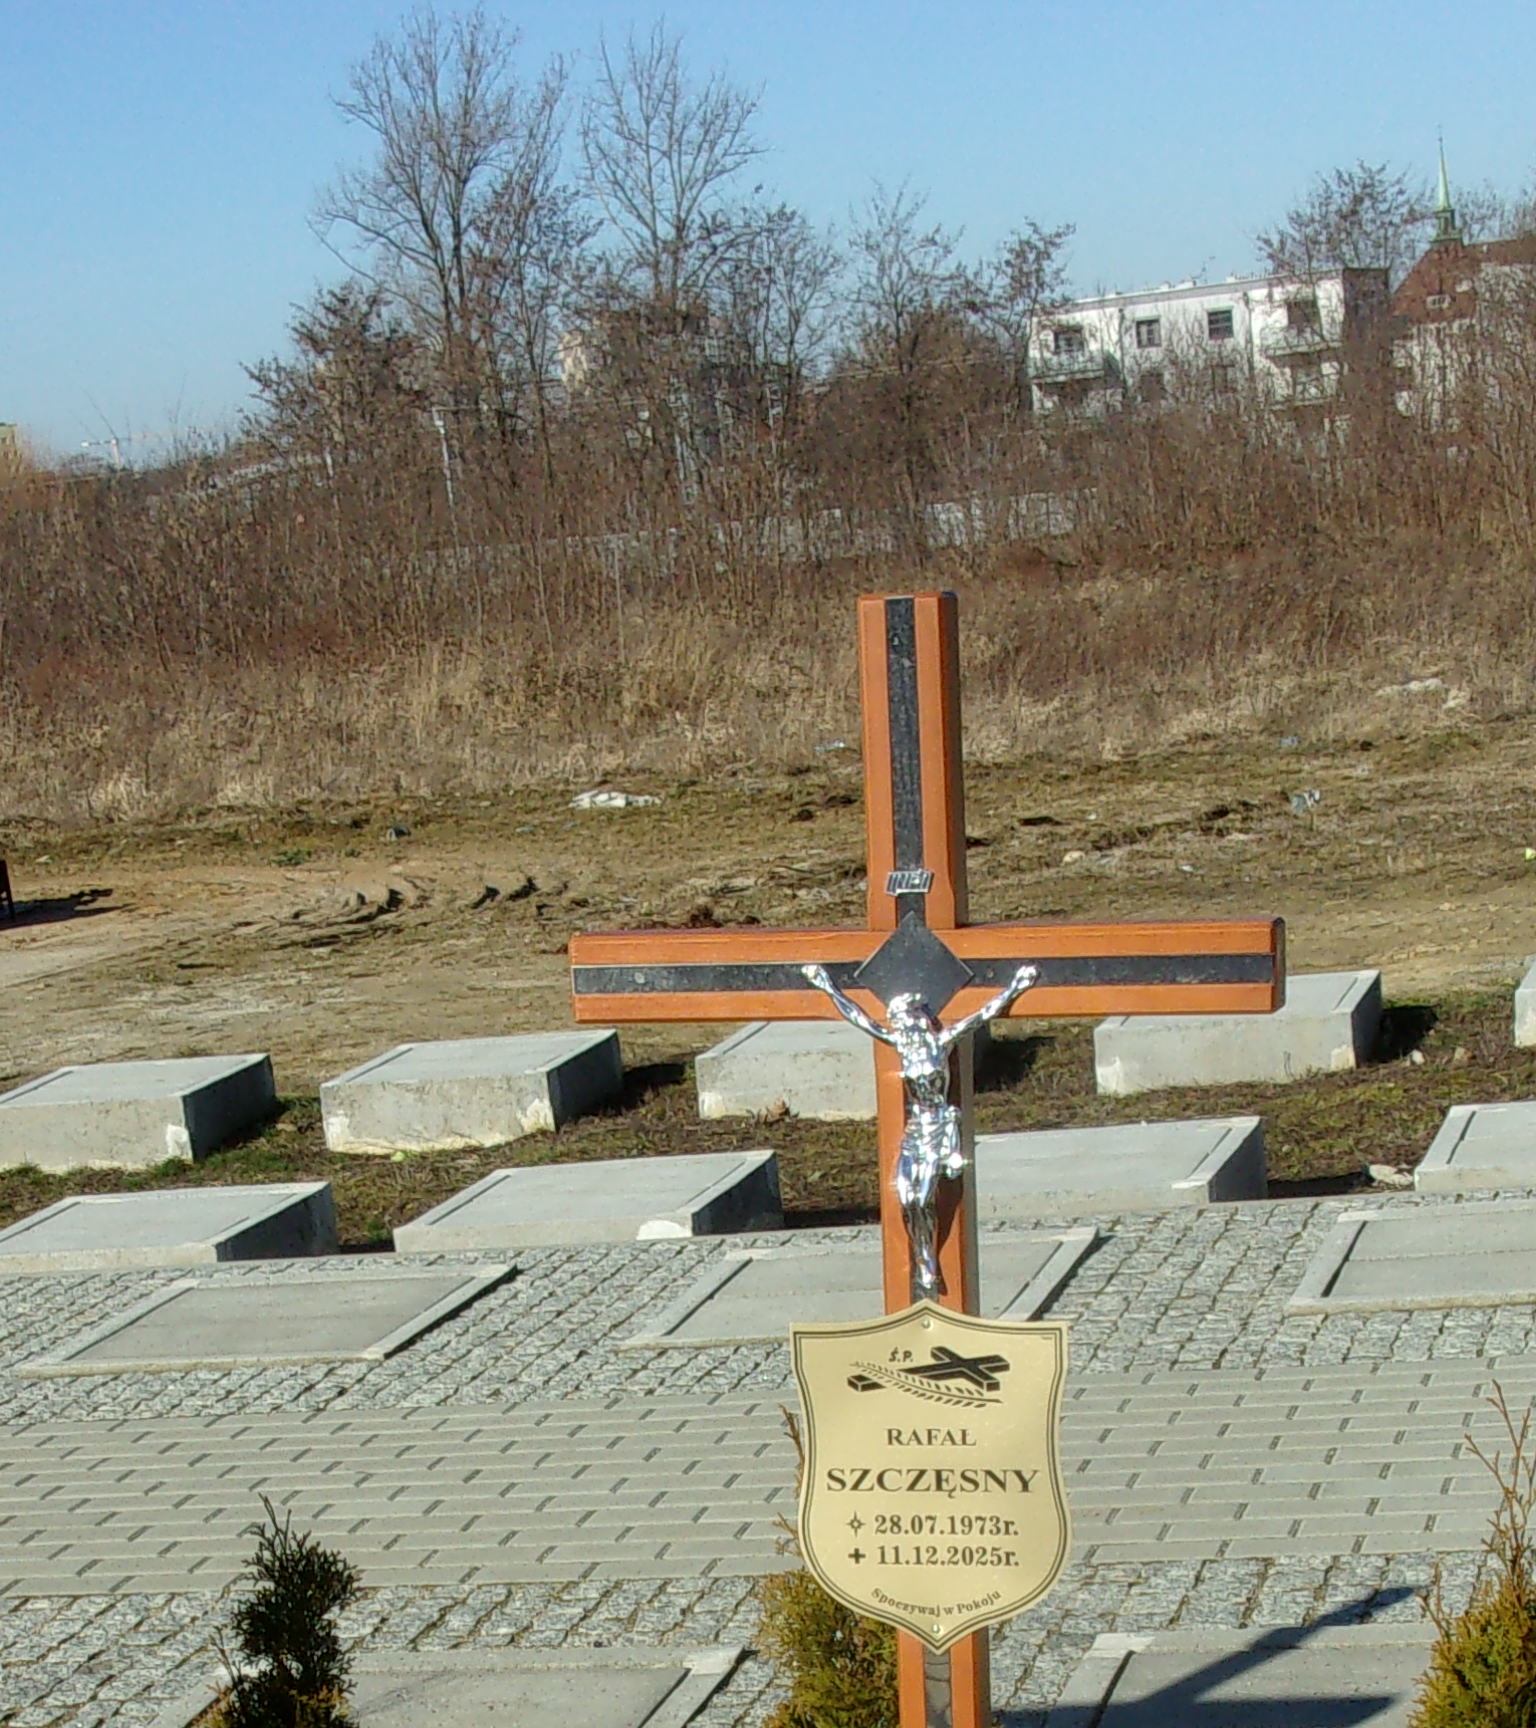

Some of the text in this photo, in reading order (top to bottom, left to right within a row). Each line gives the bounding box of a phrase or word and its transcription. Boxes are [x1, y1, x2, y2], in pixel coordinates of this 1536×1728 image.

[886, 1428, 977, 1447] RAFAŁ
[826, 1467, 1040, 1498] SZCZĘSNY
[874, 1514, 1019, 1537] 28.07.1973r.
[877, 1545, 1020, 1567] 11.12.2025r.
[871, 1587, 941, 1618] Spoczywaj
[956, 1589, 1002, 1614] Pokoju
